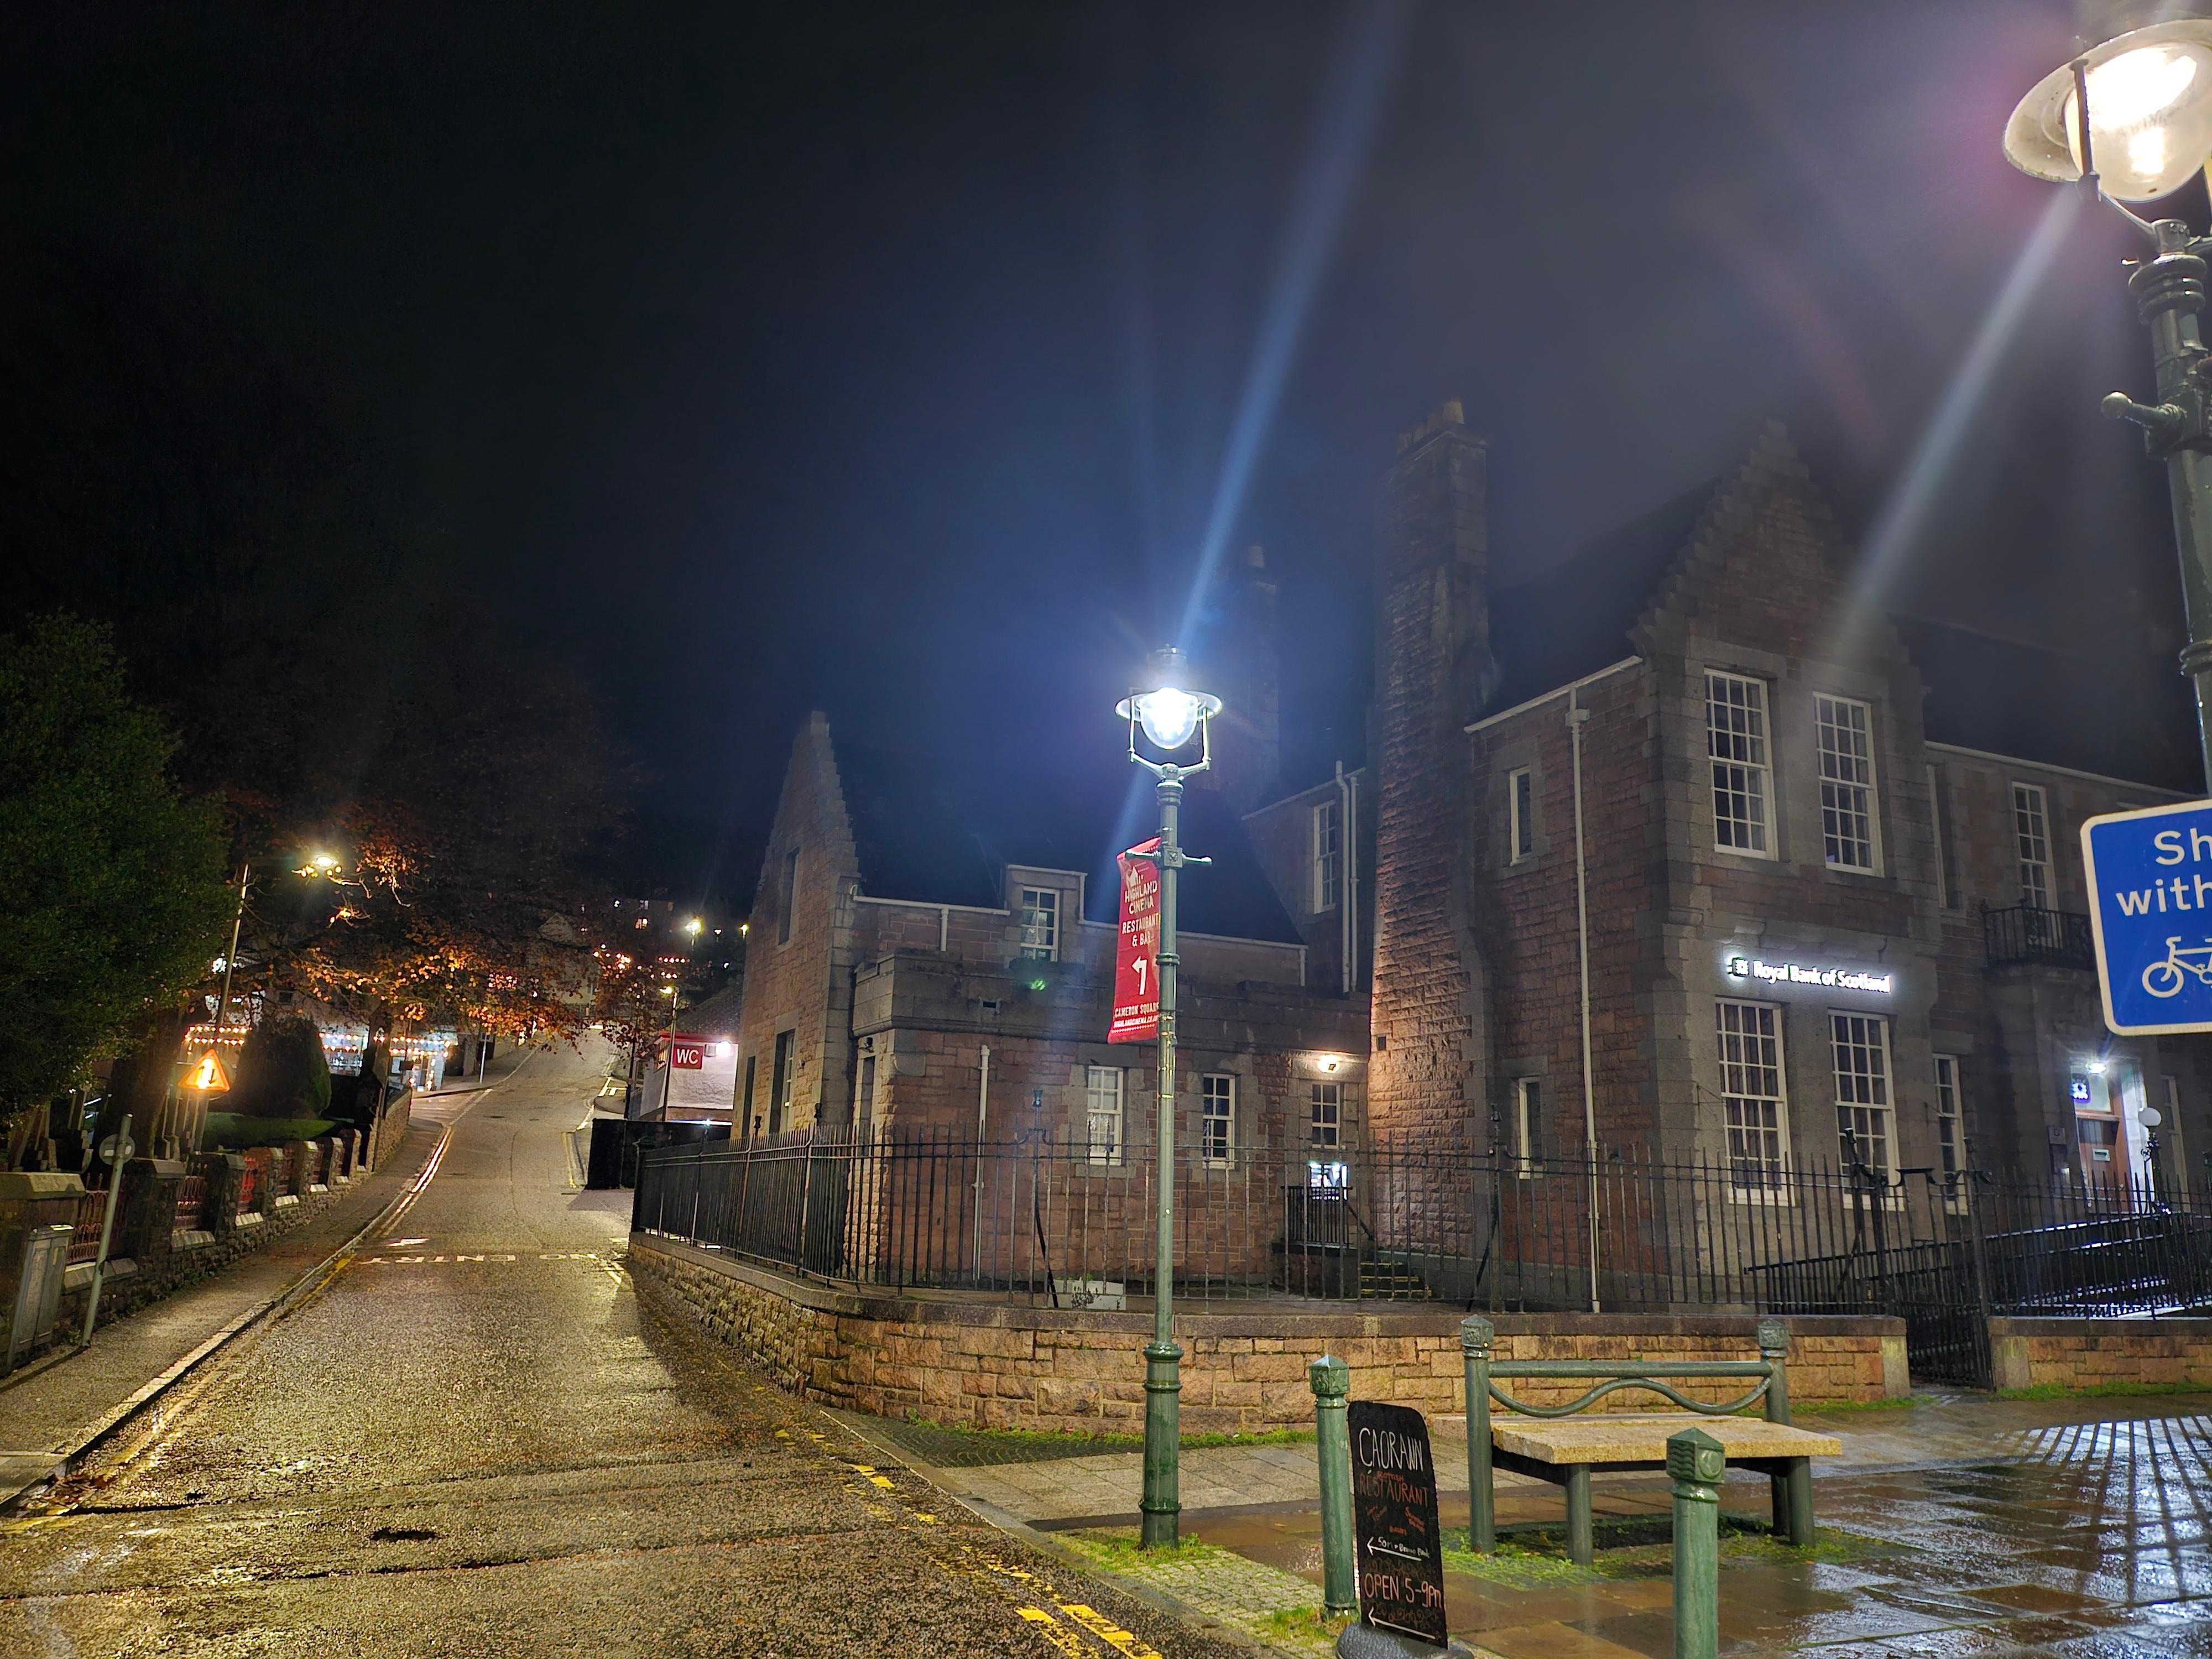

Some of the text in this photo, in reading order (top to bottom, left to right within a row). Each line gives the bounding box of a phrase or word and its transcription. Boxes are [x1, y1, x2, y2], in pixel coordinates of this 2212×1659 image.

[1125, 880, 1158, 903] HIGHLAND
[2116, 874, 2212, 916] with
[1129, 895, 1154, 915] CINEMA
[1122, 914, 1159, 935] RESTAURANT
[1132, 931, 1152, 947] & BAR
[1753, 960, 1891, 993] Royal Bank of Scotland
[1114, 1005, 1139, 1018] CAMERON
[676, 1048, 699, 1065] WC
[1359, 1427, 1423, 1472] CAORANN
[1364, 1573, 1400, 1601] OPEN
